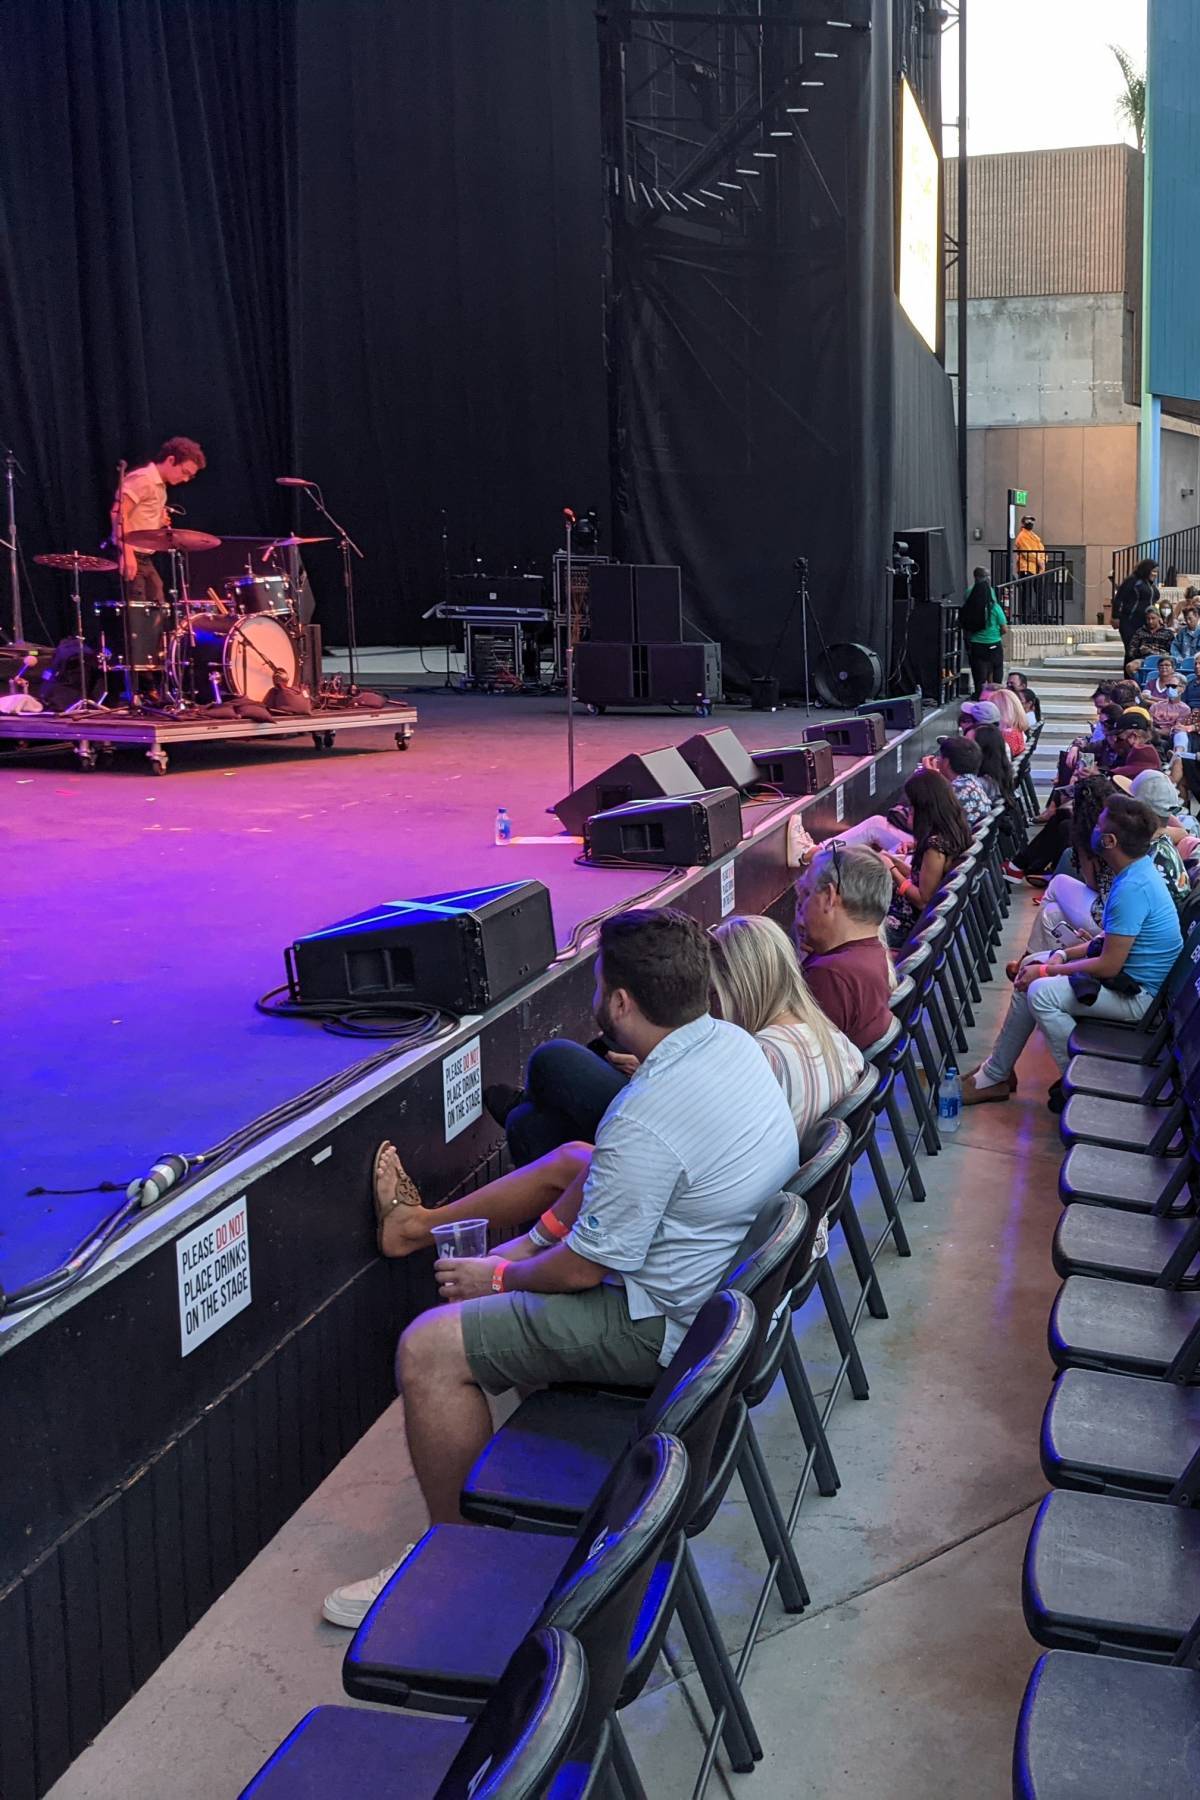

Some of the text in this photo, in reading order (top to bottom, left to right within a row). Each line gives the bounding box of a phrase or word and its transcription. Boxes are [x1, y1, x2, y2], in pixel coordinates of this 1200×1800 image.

[445, 1058, 463, 1085] PLEASE
[446, 1067, 480, 1107] PLACE DRINKS
[447, 1088, 480, 1129] ON THE STAGE
[182, 1211, 245, 1274] PLEASE DO NOT
[184, 1240, 247, 1307] PLACE DRINKS
[185, 1267, 248, 1335] ON THE STAGE
